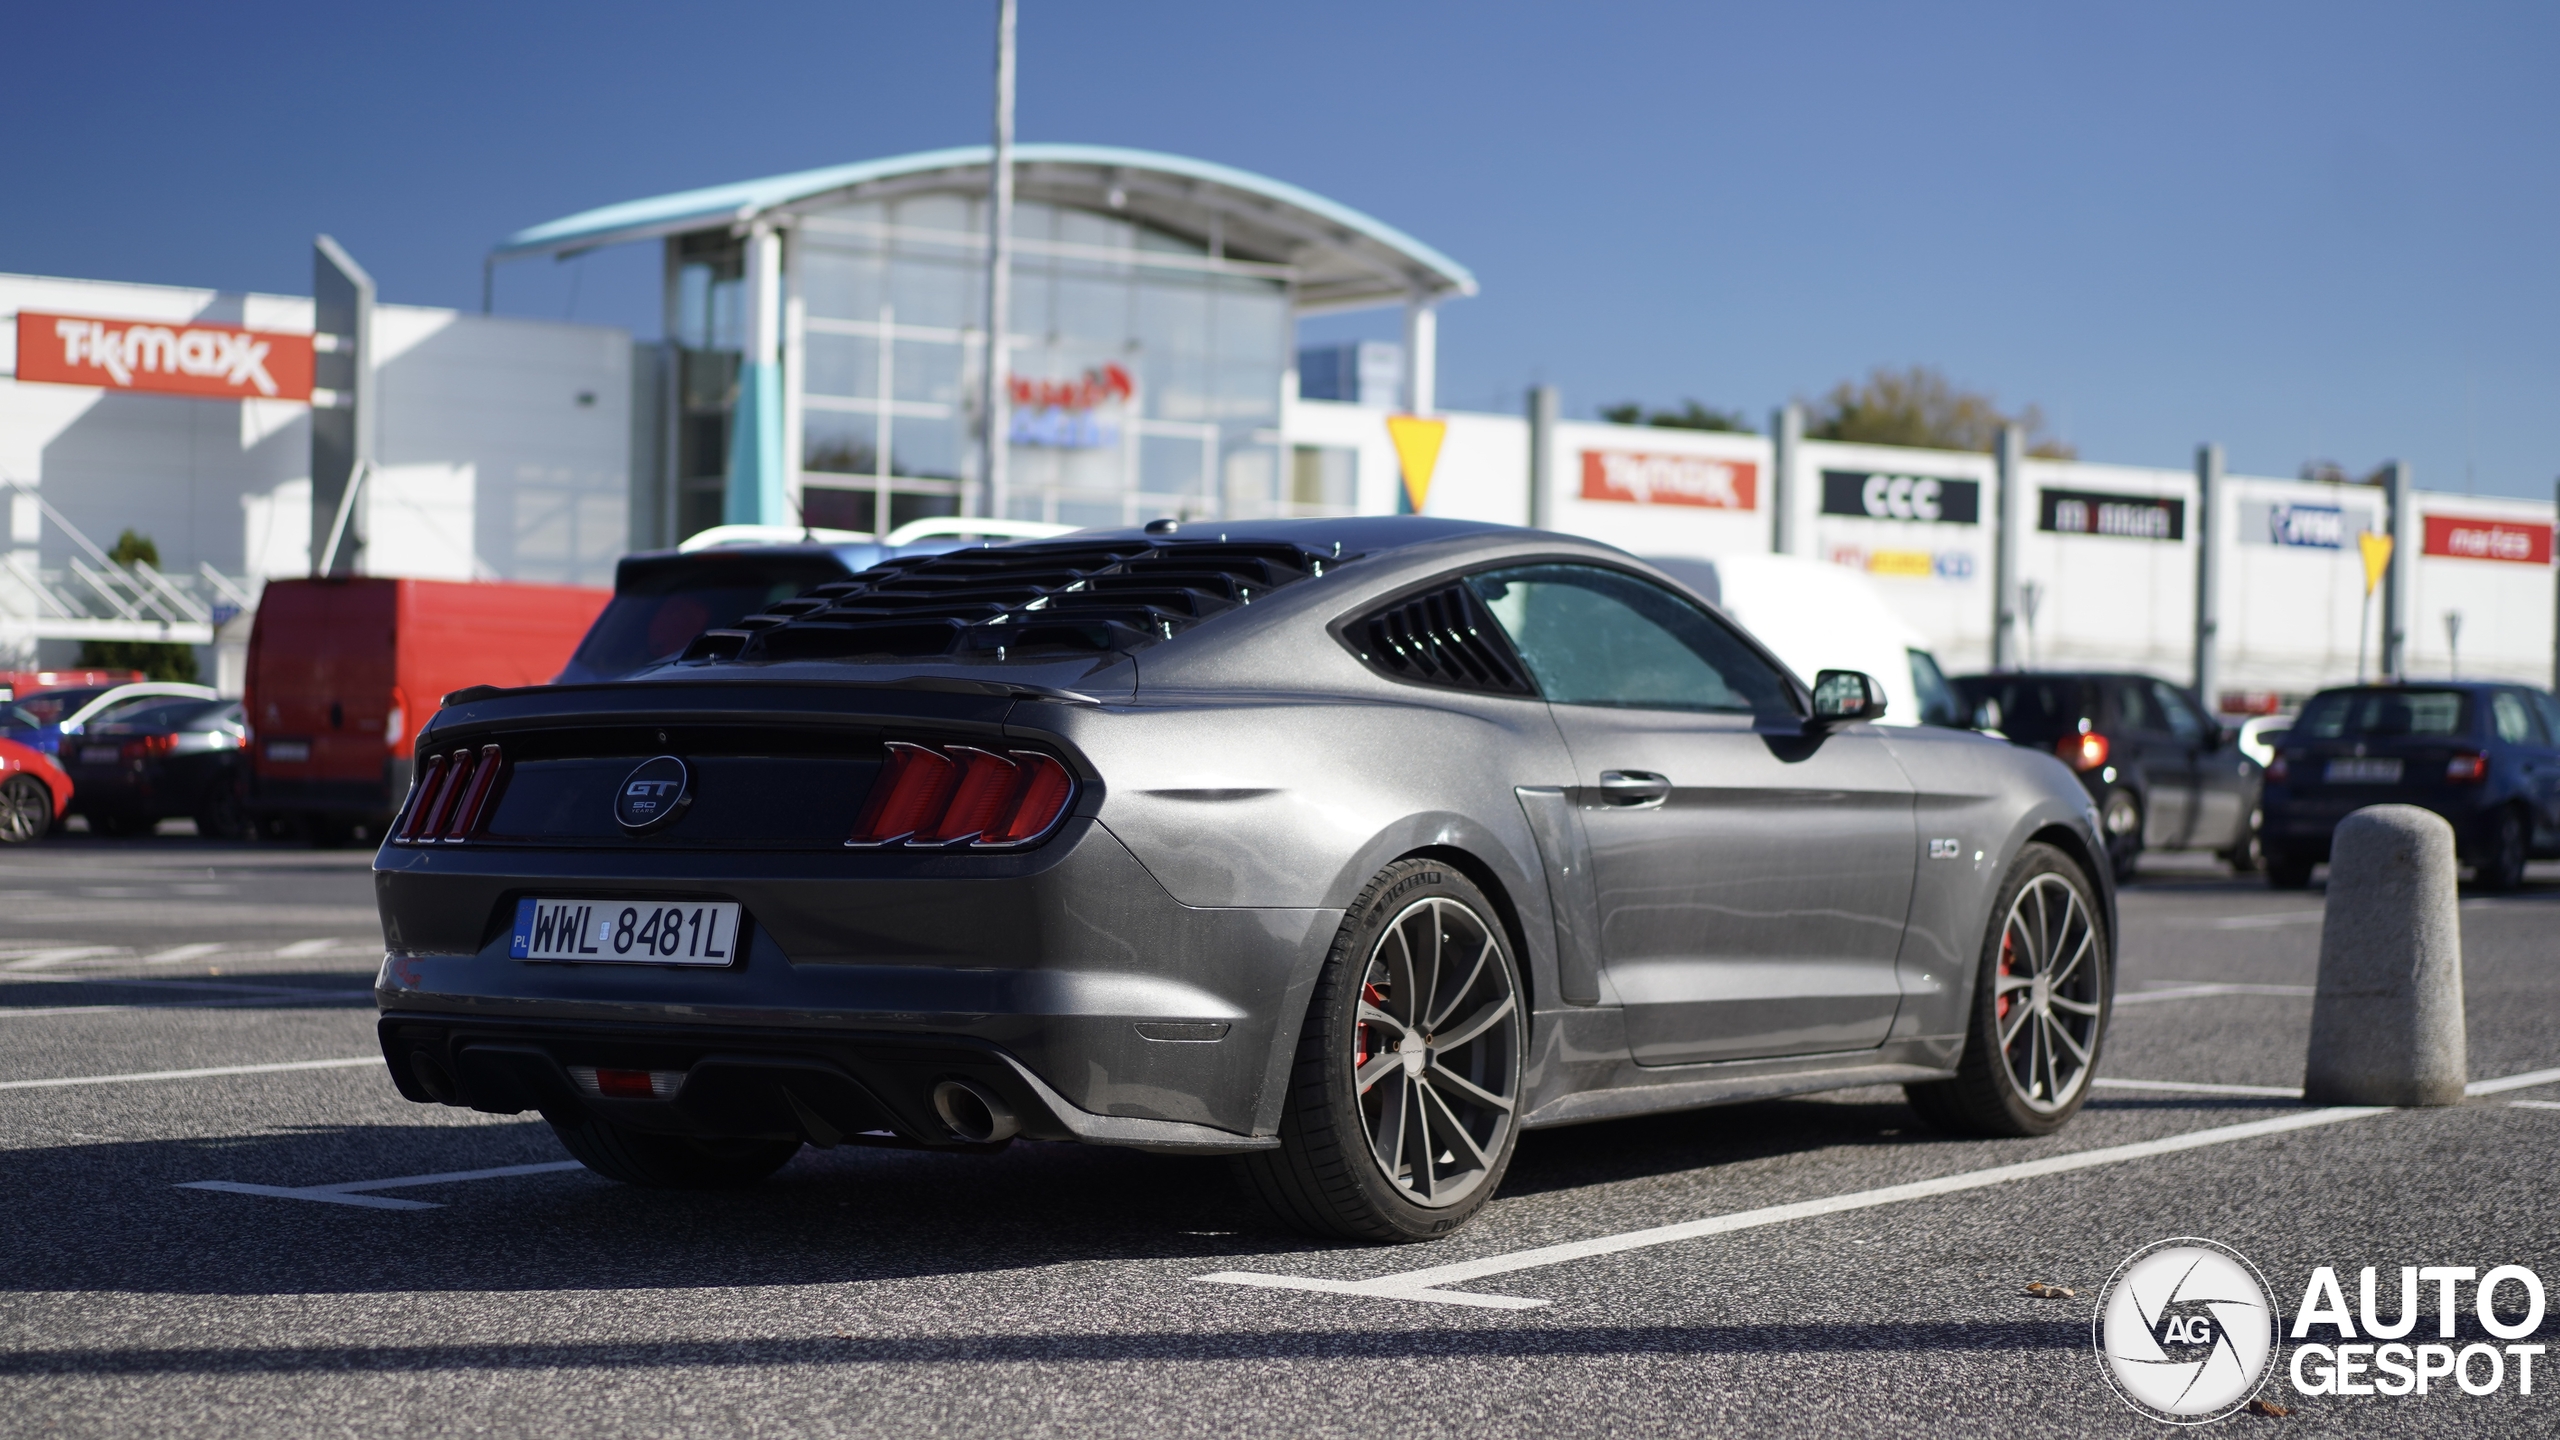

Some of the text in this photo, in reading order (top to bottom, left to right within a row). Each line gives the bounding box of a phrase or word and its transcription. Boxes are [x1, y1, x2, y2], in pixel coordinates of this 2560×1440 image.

[1862, 474, 1942, 520] CCC
[627, 781, 678, 796] GT
[633, 801, 656, 809] 50
[1381, 872, 1439, 911] MICHELIN
[514, 935, 527, 948] PL
[533, 905, 725, 958] WWL 8481L
